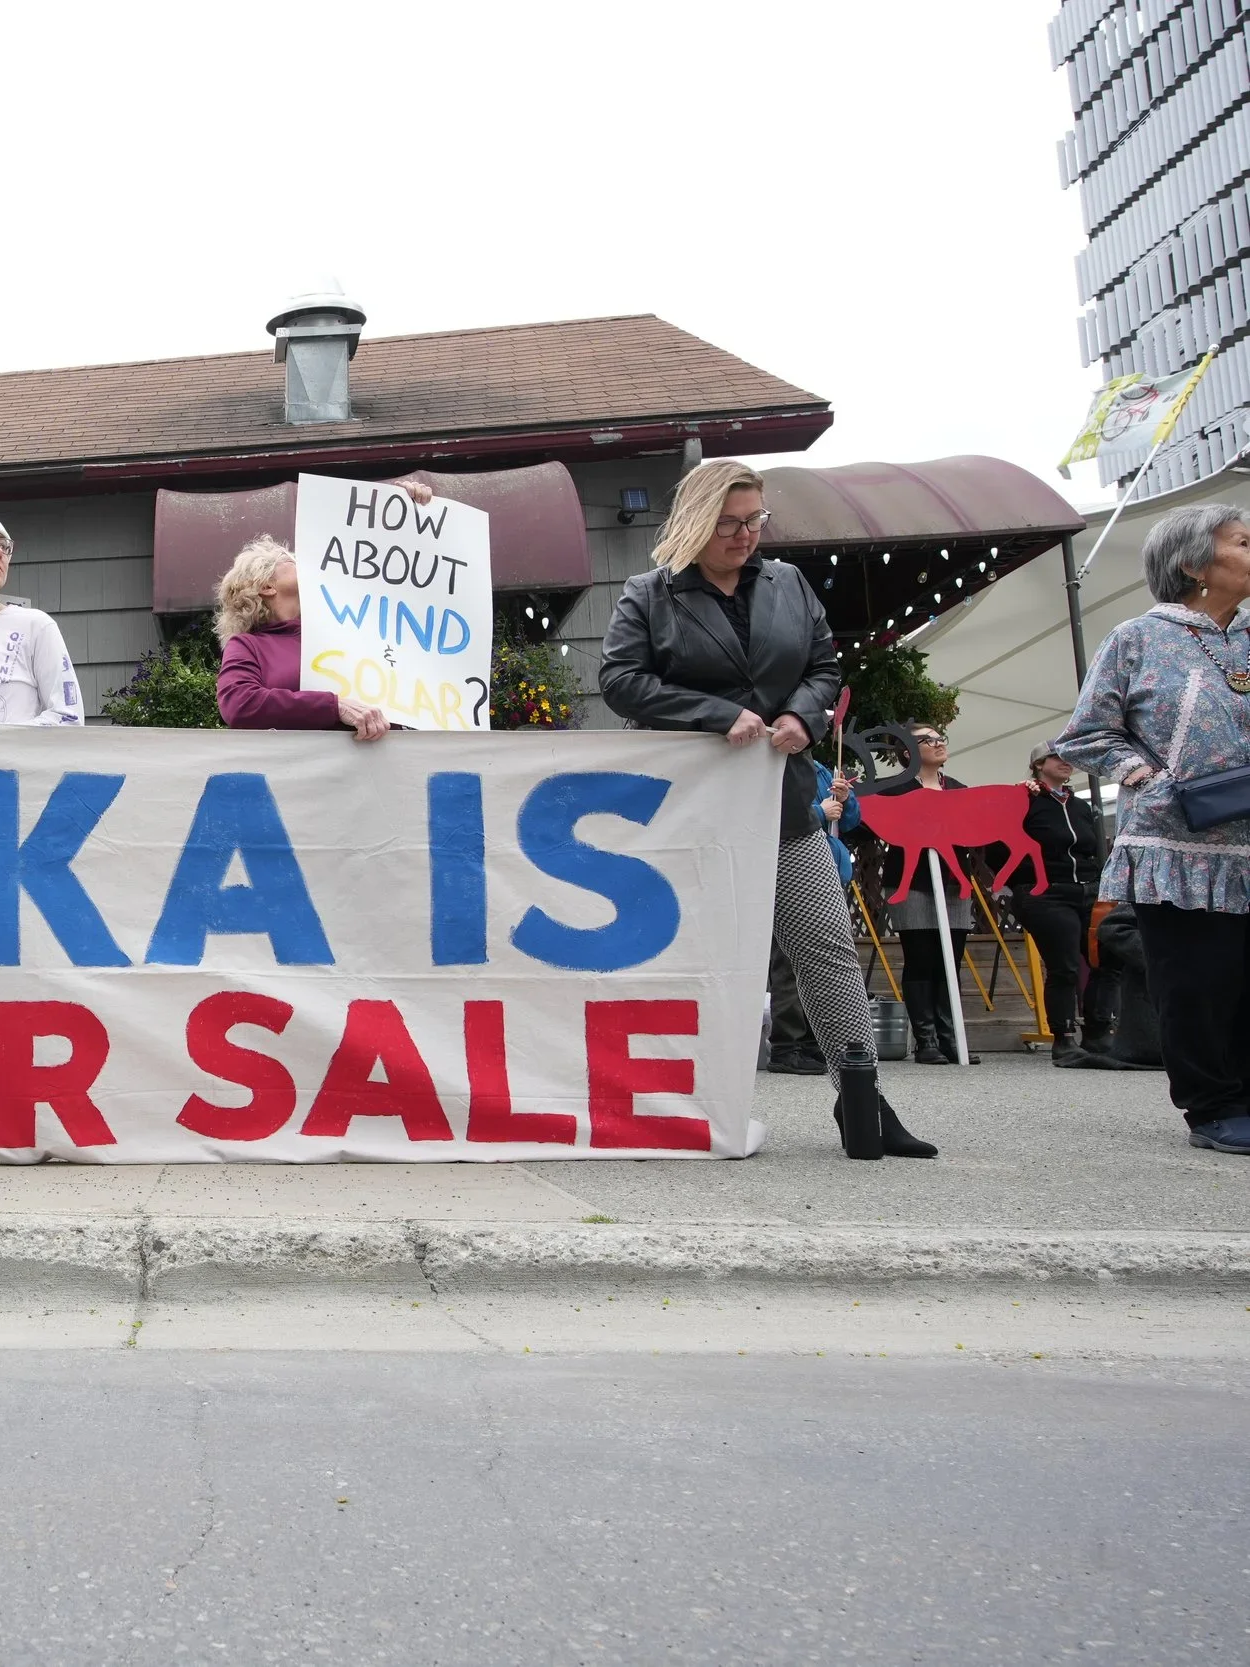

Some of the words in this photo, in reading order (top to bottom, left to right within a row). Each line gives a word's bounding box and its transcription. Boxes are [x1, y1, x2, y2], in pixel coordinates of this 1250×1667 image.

[347, 486, 448, 540] HOW
[320, 536, 468, 595] ABOUT
[320, 584, 471, 655] WIND
[426, 771, 681, 973] IS
[175, 991, 711, 1152] SALE
